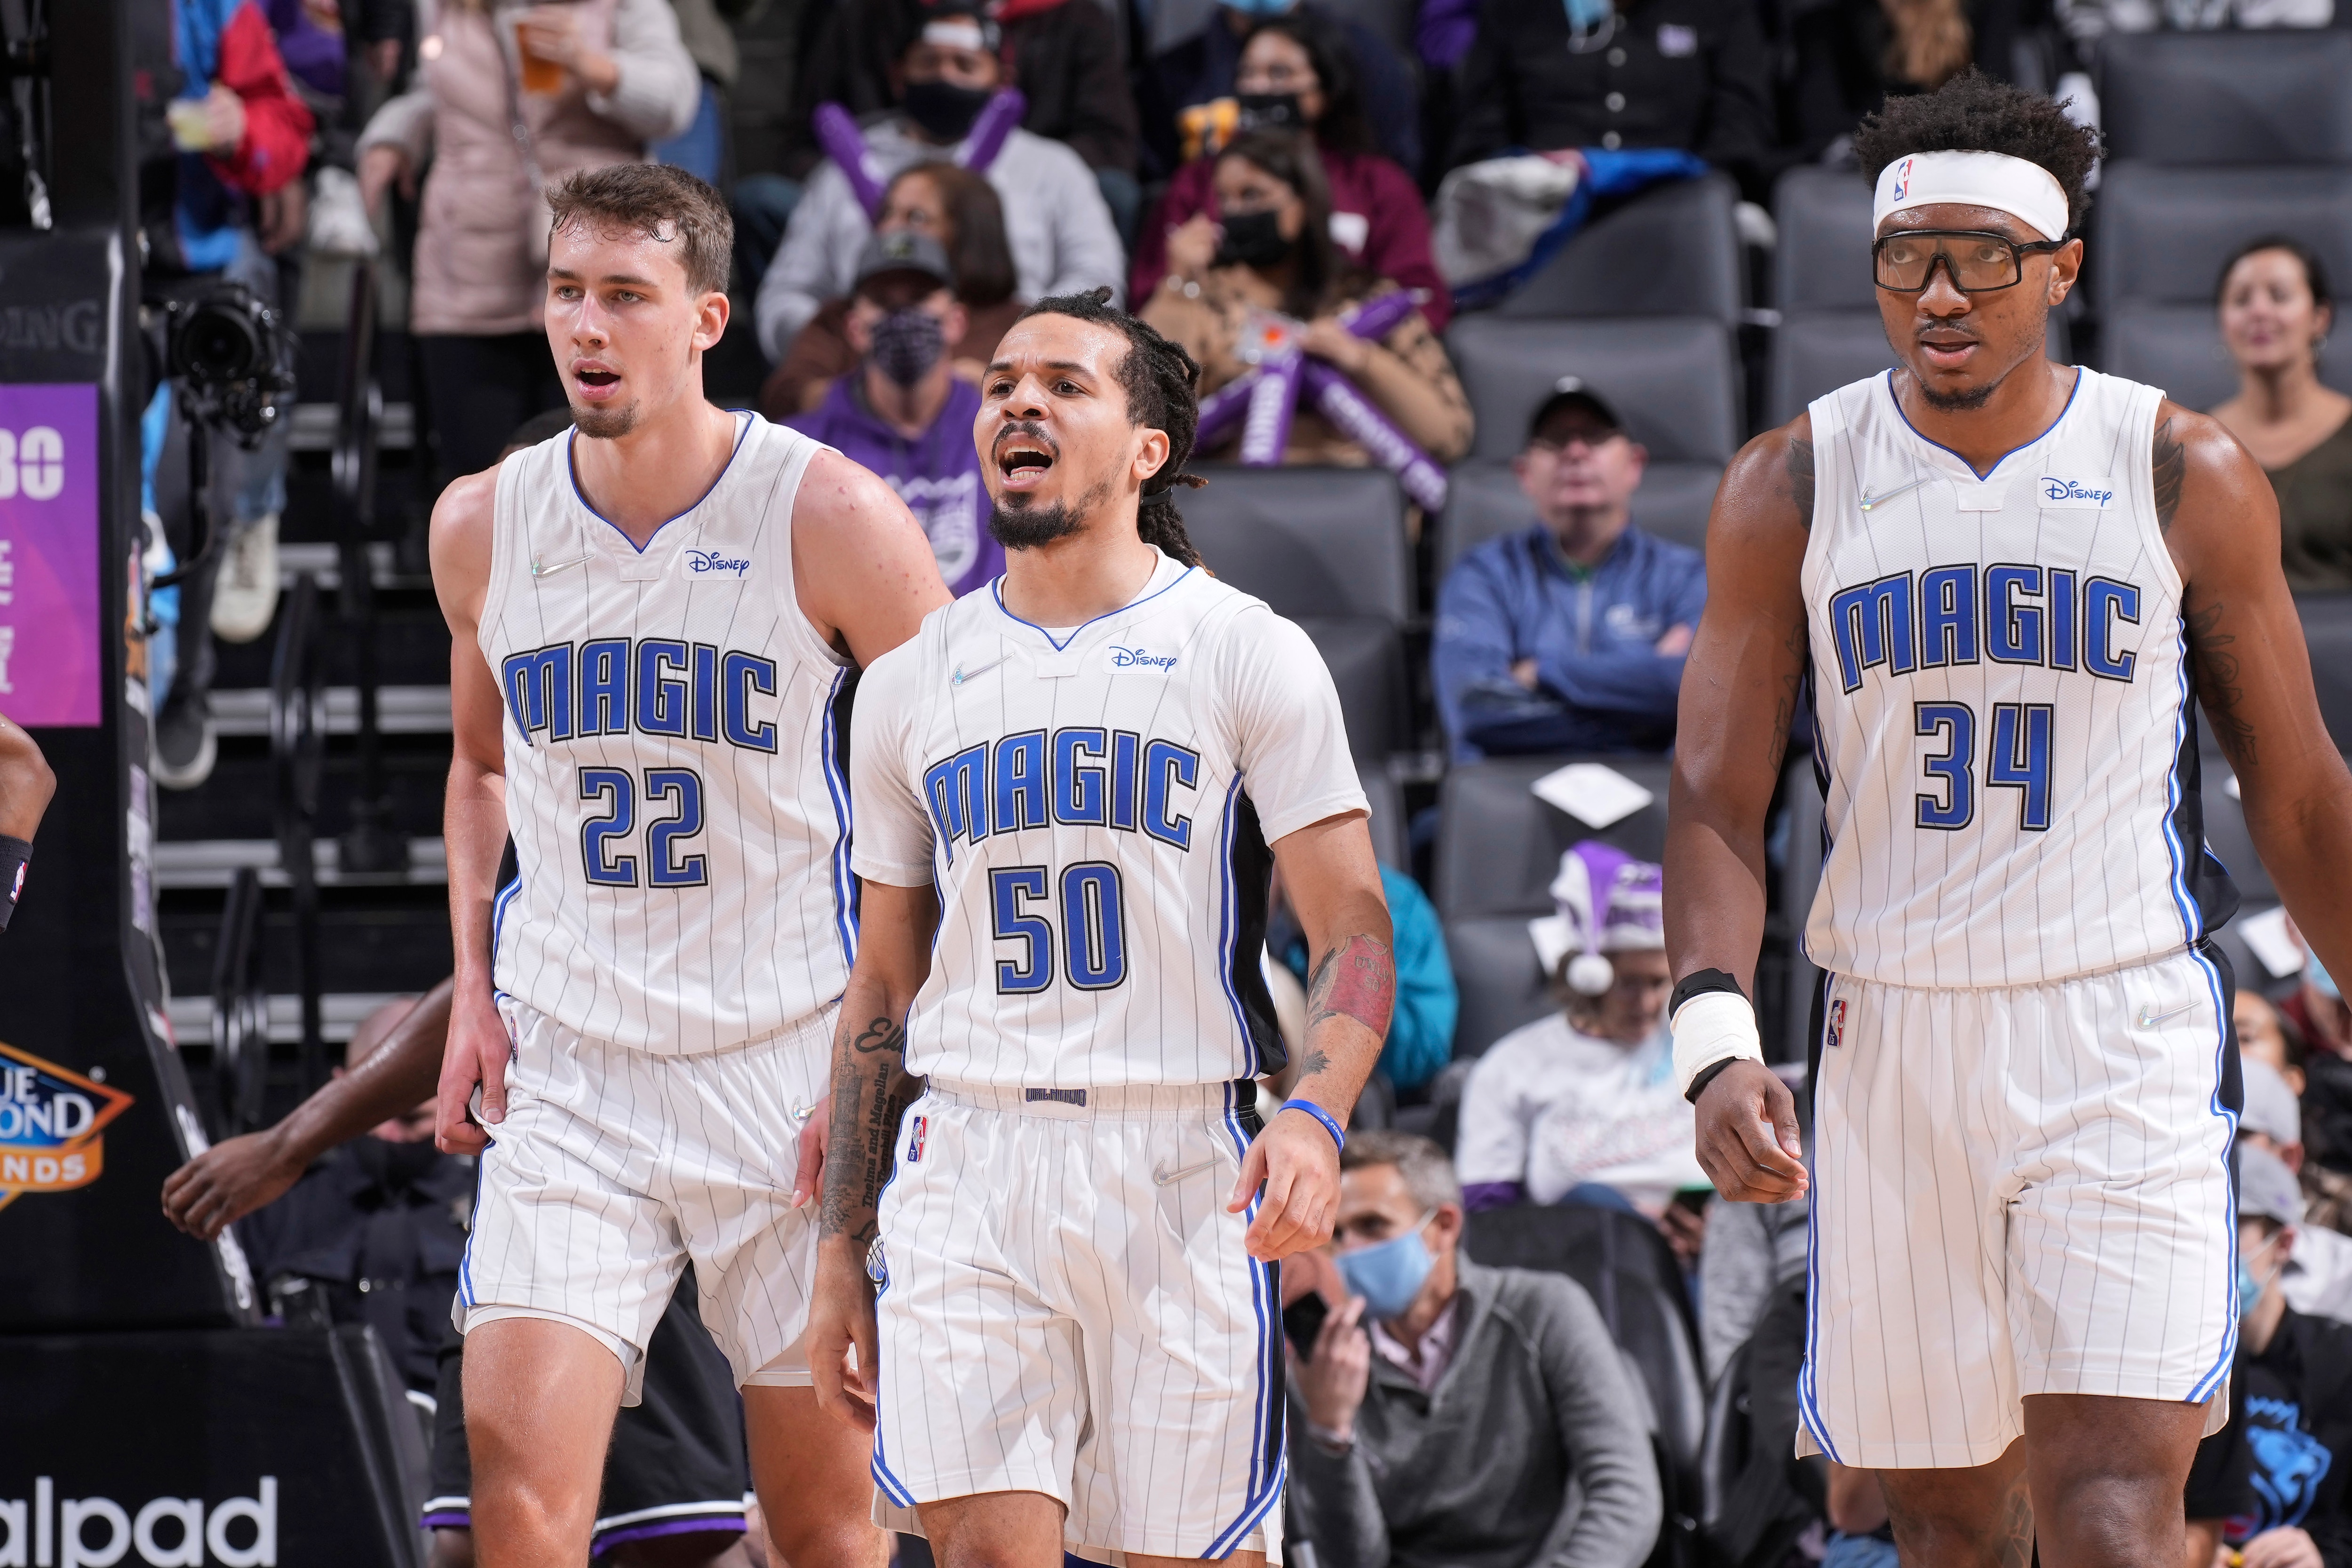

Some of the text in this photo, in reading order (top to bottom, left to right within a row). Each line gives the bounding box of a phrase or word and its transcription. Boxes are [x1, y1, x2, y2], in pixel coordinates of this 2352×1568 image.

[0, 299, 100, 353] ING
[2041, 477, 2112, 507] Disney
[685, 550, 750, 578] Disney
[1829, 563, 2140, 695] MAGIC
[1109, 646, 1177, 673] Disney
[501, 637, 778, 755] MAGIC
[1915, 701, 2053, 831] 34
[923, 727, 1200, 872] MAGIC
[579, 767, 708, 888] 22
[989, 861, 1127, 995] 50
[1355, 956, 1389, 983] UNLV
[1828, 1034, 1835, 1044] 75
[868, 1127, 879, 1155] and
[909, 1149, 915, 1160] 75
[2, 1154, 87, 1183] NDS
